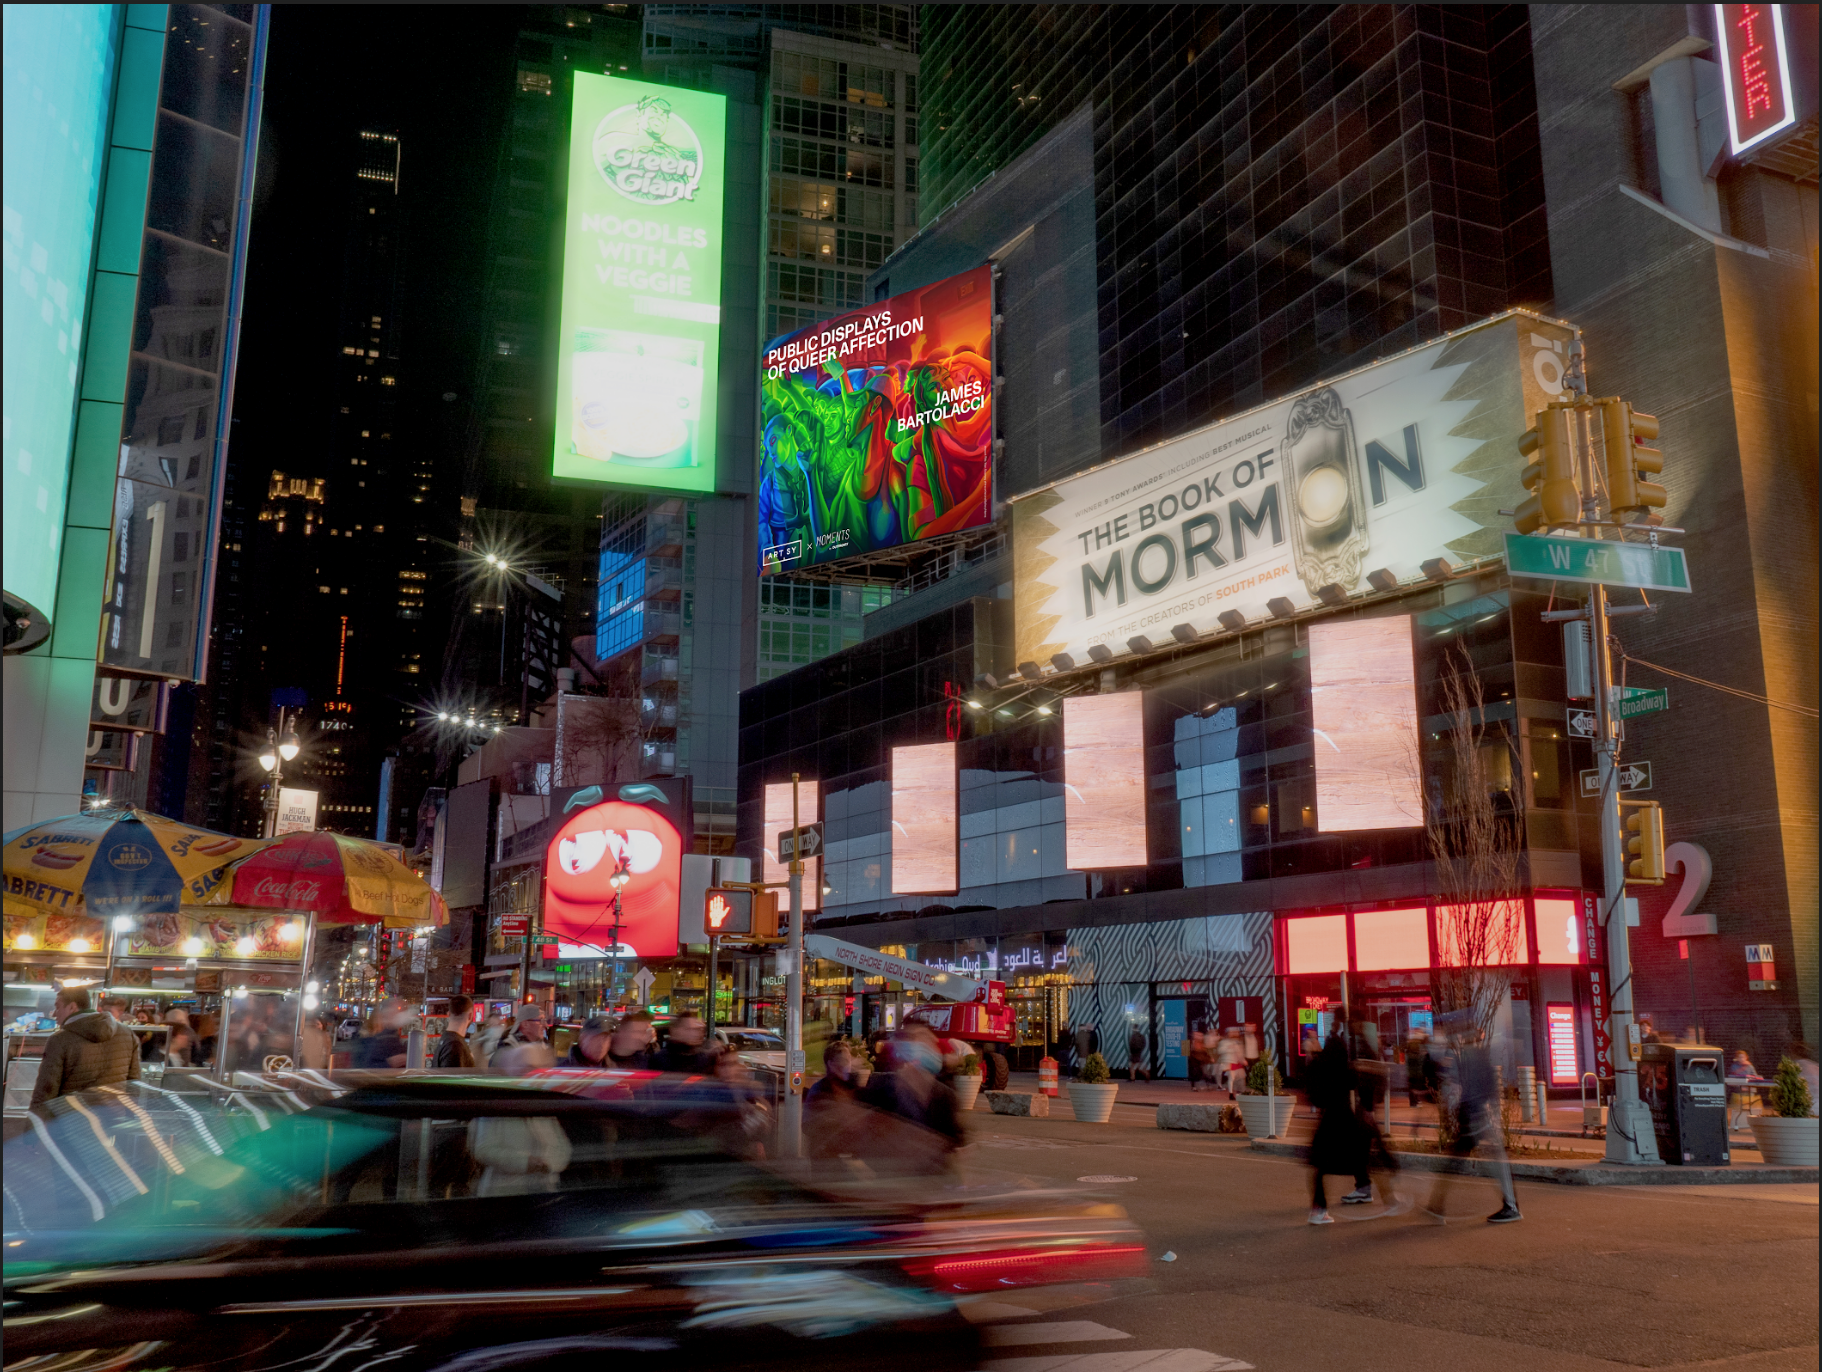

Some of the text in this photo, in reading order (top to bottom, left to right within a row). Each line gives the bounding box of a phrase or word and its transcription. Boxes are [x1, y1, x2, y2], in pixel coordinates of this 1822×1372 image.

[1738, 4, 1771, 119] TER
[606, 148, 696, 177] Green
[616, 169, 699, 201] Giant
[581, 212, 707, 248] NOODLES
[598, 239, 690, 271] WITH A
[595, 264, 691, 296] VEGGIE
[768, 311, 892, 365] PUBLIC DISPLAYS
[768, 316, 924, 380] OF QUEER AFFECTION
[935, 380, 982, 406] JAMES
[897, 395, 985, 432] BARTOLACCI
[1075, 500, 1103, 518] WINNER
[1111, 488, 1131, 502] TONY
[1168, 452, 1211, 476] INCLUDING
[1212, 441, 1233, 455] BEST
[1235, 424, 1272, 444] MUSICAL
[1078, 448, 1274, 555] THE BOOK OF
[816, 528, 850, 547] MOMENTS
[1548, 544, 1648, 578] W 47 St
[1087, 564, 1290, 647] FROM THE CREATORS OF SOUTH PARK
[1621, 693, 1664, 716] Broadway
[320, 720, 348, 730] 1740
[1577, 718, 1592, 730] ONE
[282, 814, 311, 823] JACKMAN
[289, 807, 306, 815] HUGH
[20, 834, 96, 849] SABRETT
[785, 834, 817, 852] ON WAY
[3, 874, 74, 908] ABRETT
[142, 895, 160, 903] ROLL
[363, 890, 383, 901] Beef
[401, 893, 424, 907] Dogs
[1662, 841, 1718, 938] 2
[1585, 897, 1597, 959] CHANGE
[250, 949, 280, 958] CHICKEN
[281, 951, 298, 959] RICE
[835, 947, 936, 987] NORTH SHORE NEON SIGN CO.
[962, 954, 980, 971] Oud
[762, 976, 786, 985] INGLOT
[1550, 1012, 1571, 1020] Change
[1591, 972, 1604, 1030] MONEY
